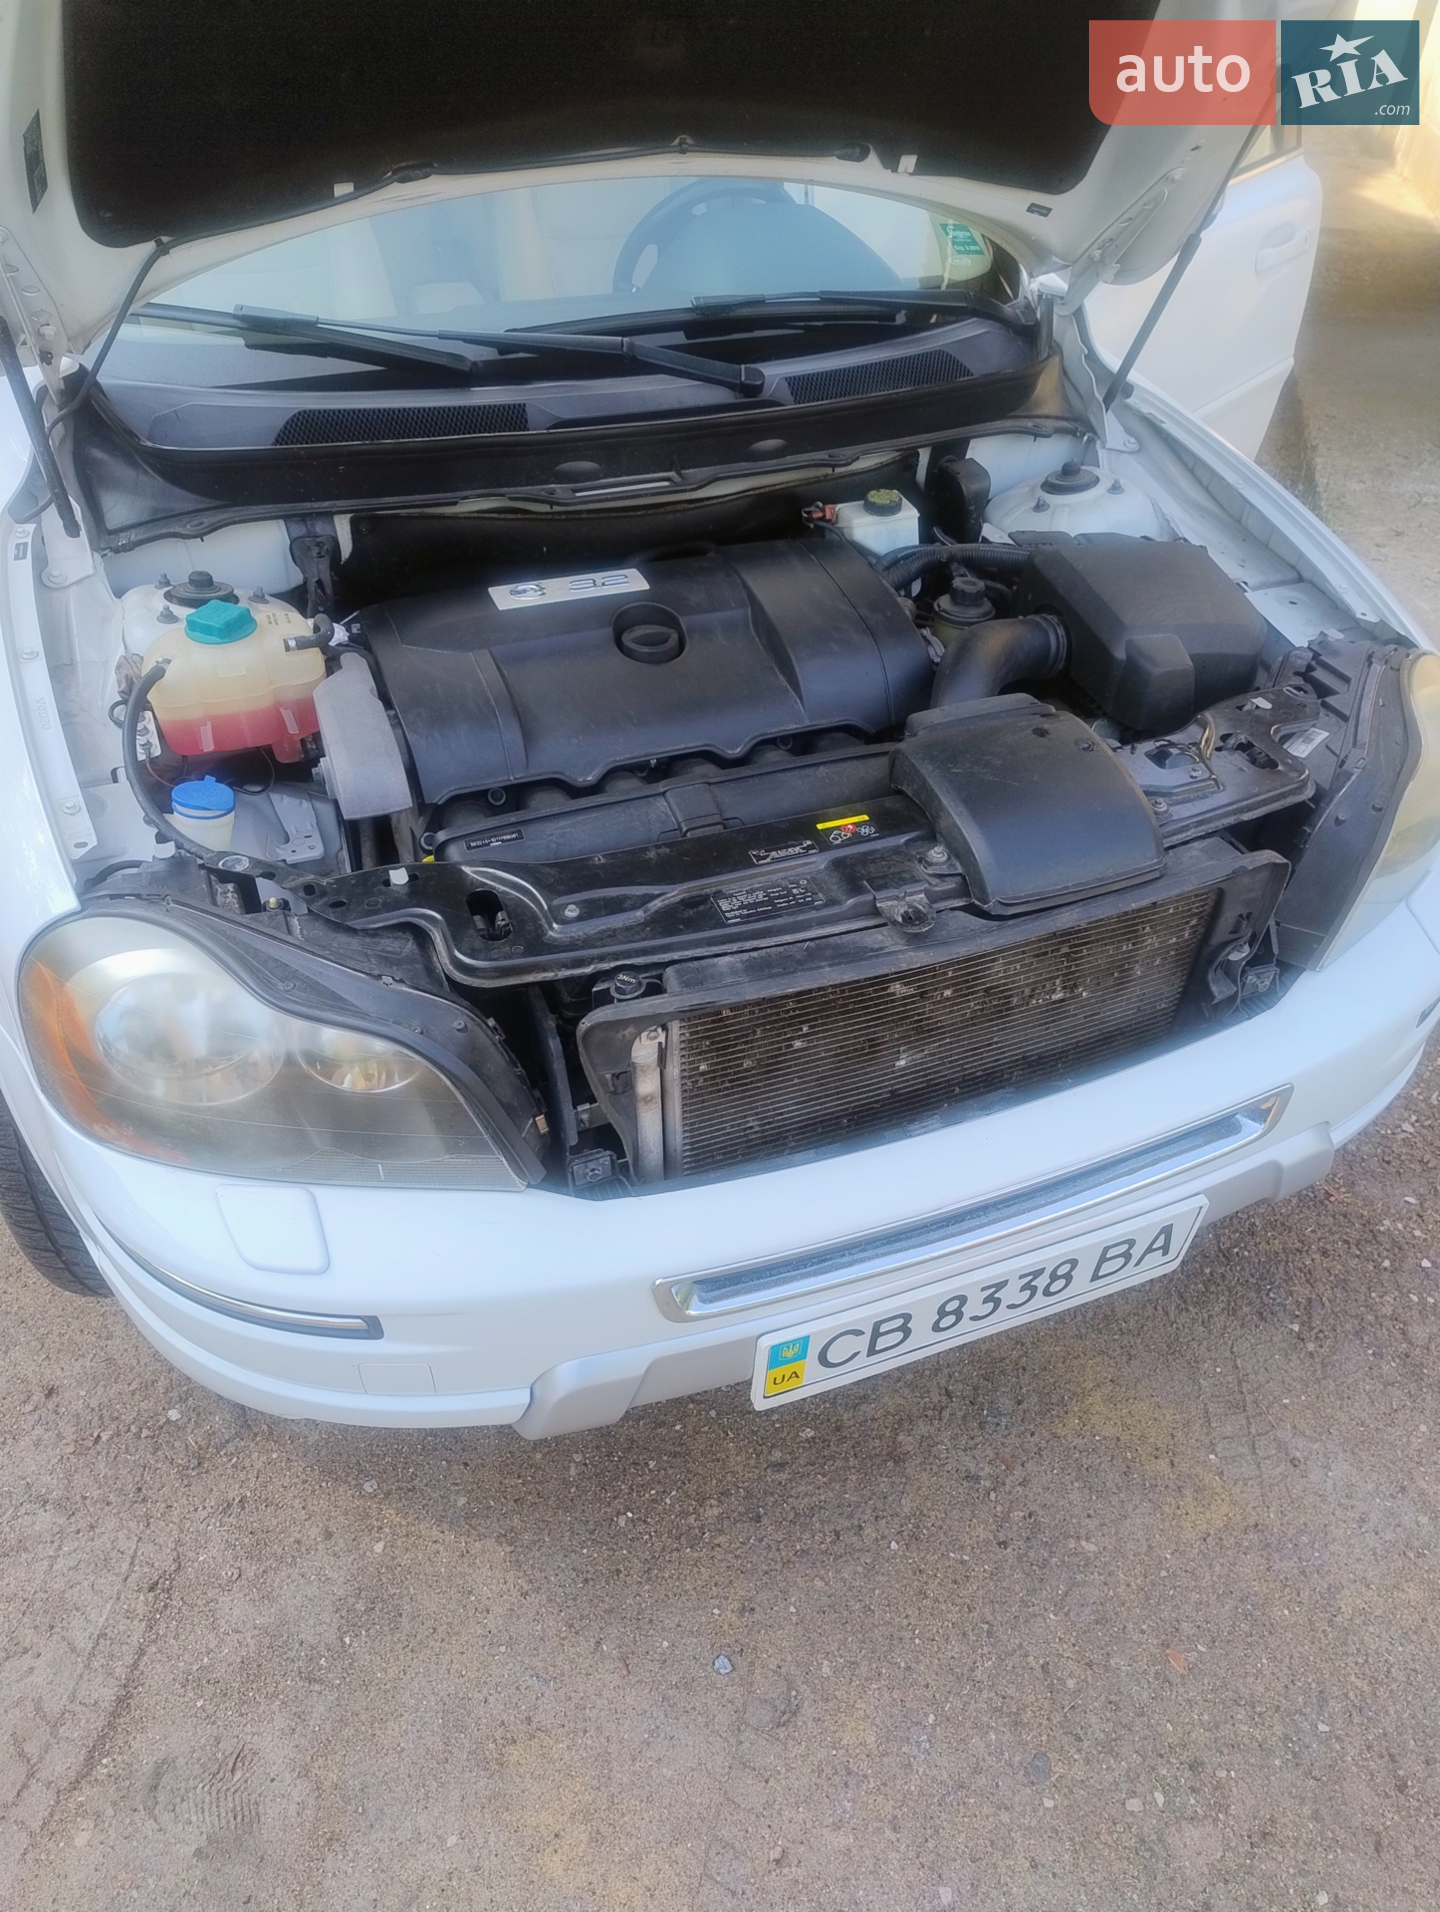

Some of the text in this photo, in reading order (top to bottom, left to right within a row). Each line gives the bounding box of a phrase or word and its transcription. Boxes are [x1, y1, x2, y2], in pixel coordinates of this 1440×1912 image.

[569, 574, 630, 593] 3.2
[818, 1223, 1173, 1369] CB 8338 BA
[773, 1370, 800, 1386] UA
